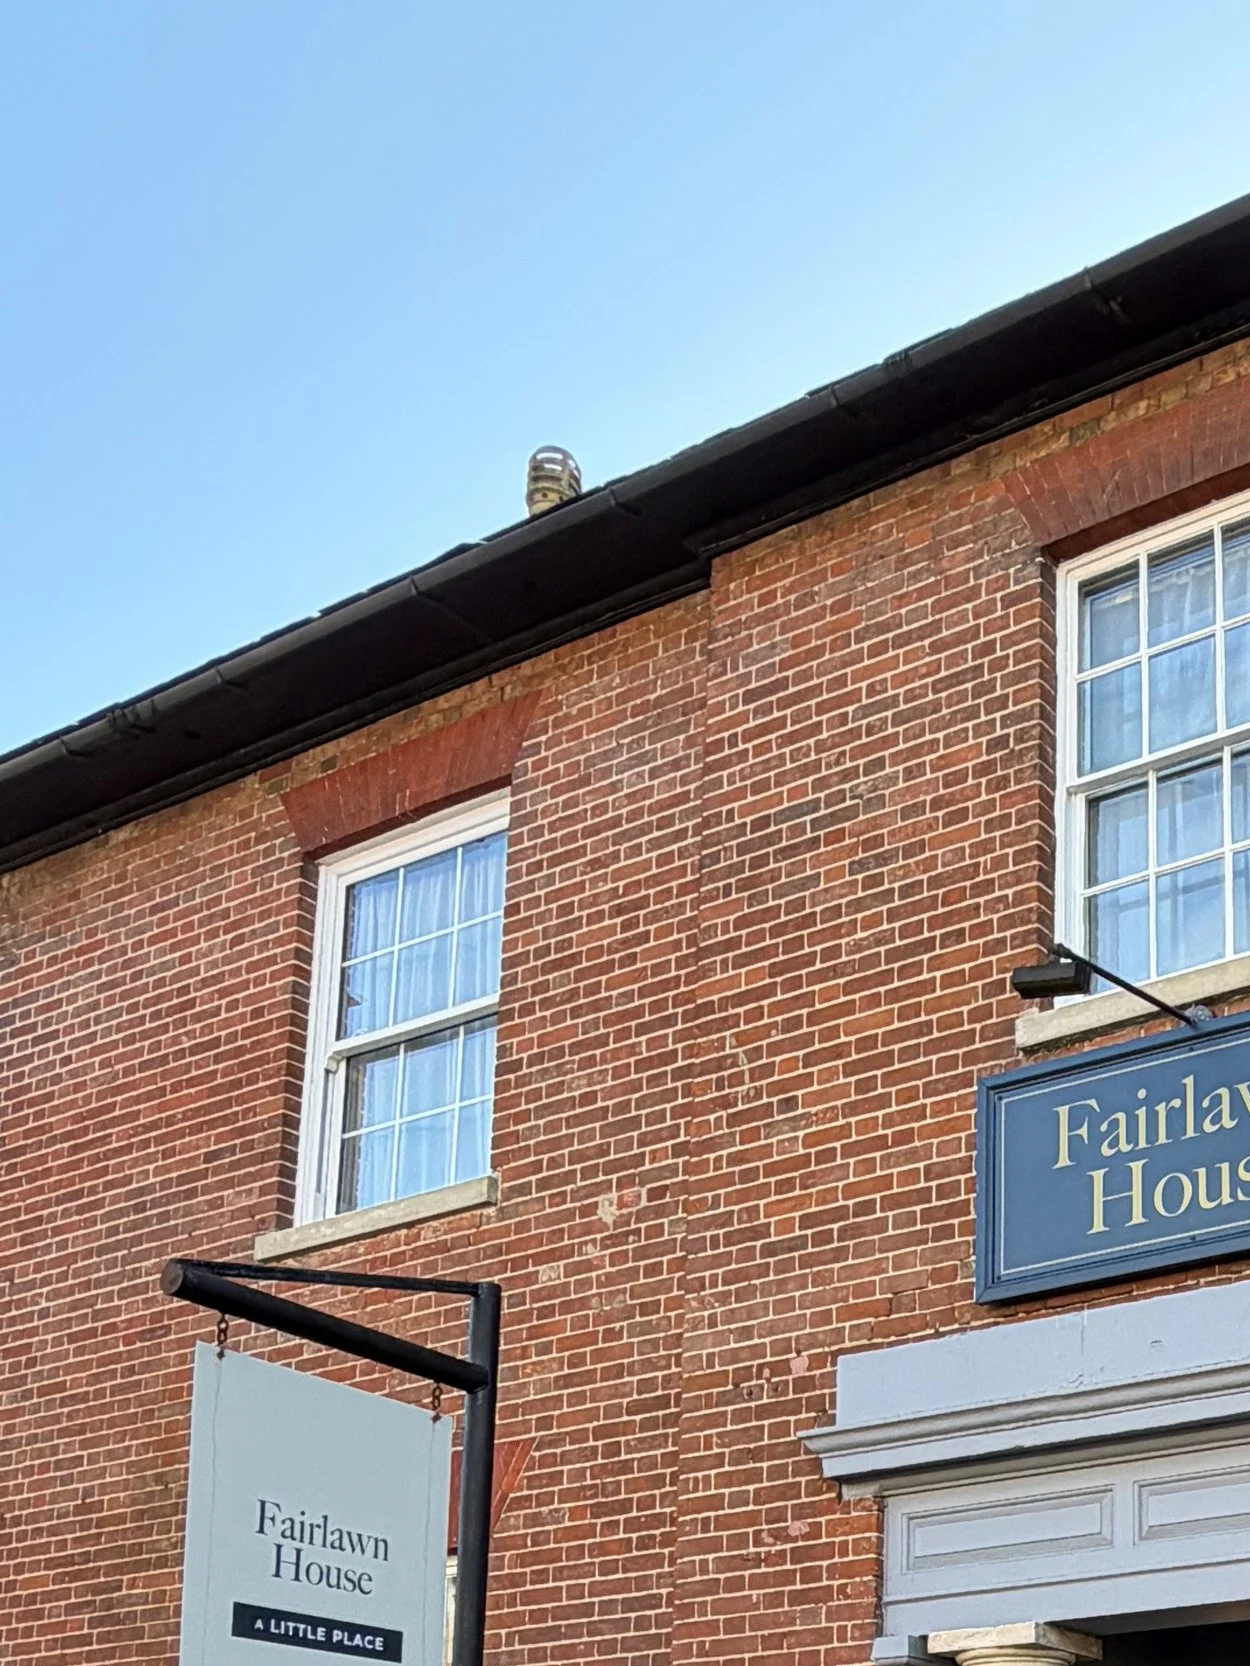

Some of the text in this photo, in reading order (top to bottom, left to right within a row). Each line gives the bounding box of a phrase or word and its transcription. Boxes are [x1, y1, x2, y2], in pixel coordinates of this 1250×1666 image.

[255, 1499, 389, 1561] Fairlawn
[271, 1542, 373, 1595] House
[254, 1618, 384, 1651] A LITTLE PLACE
